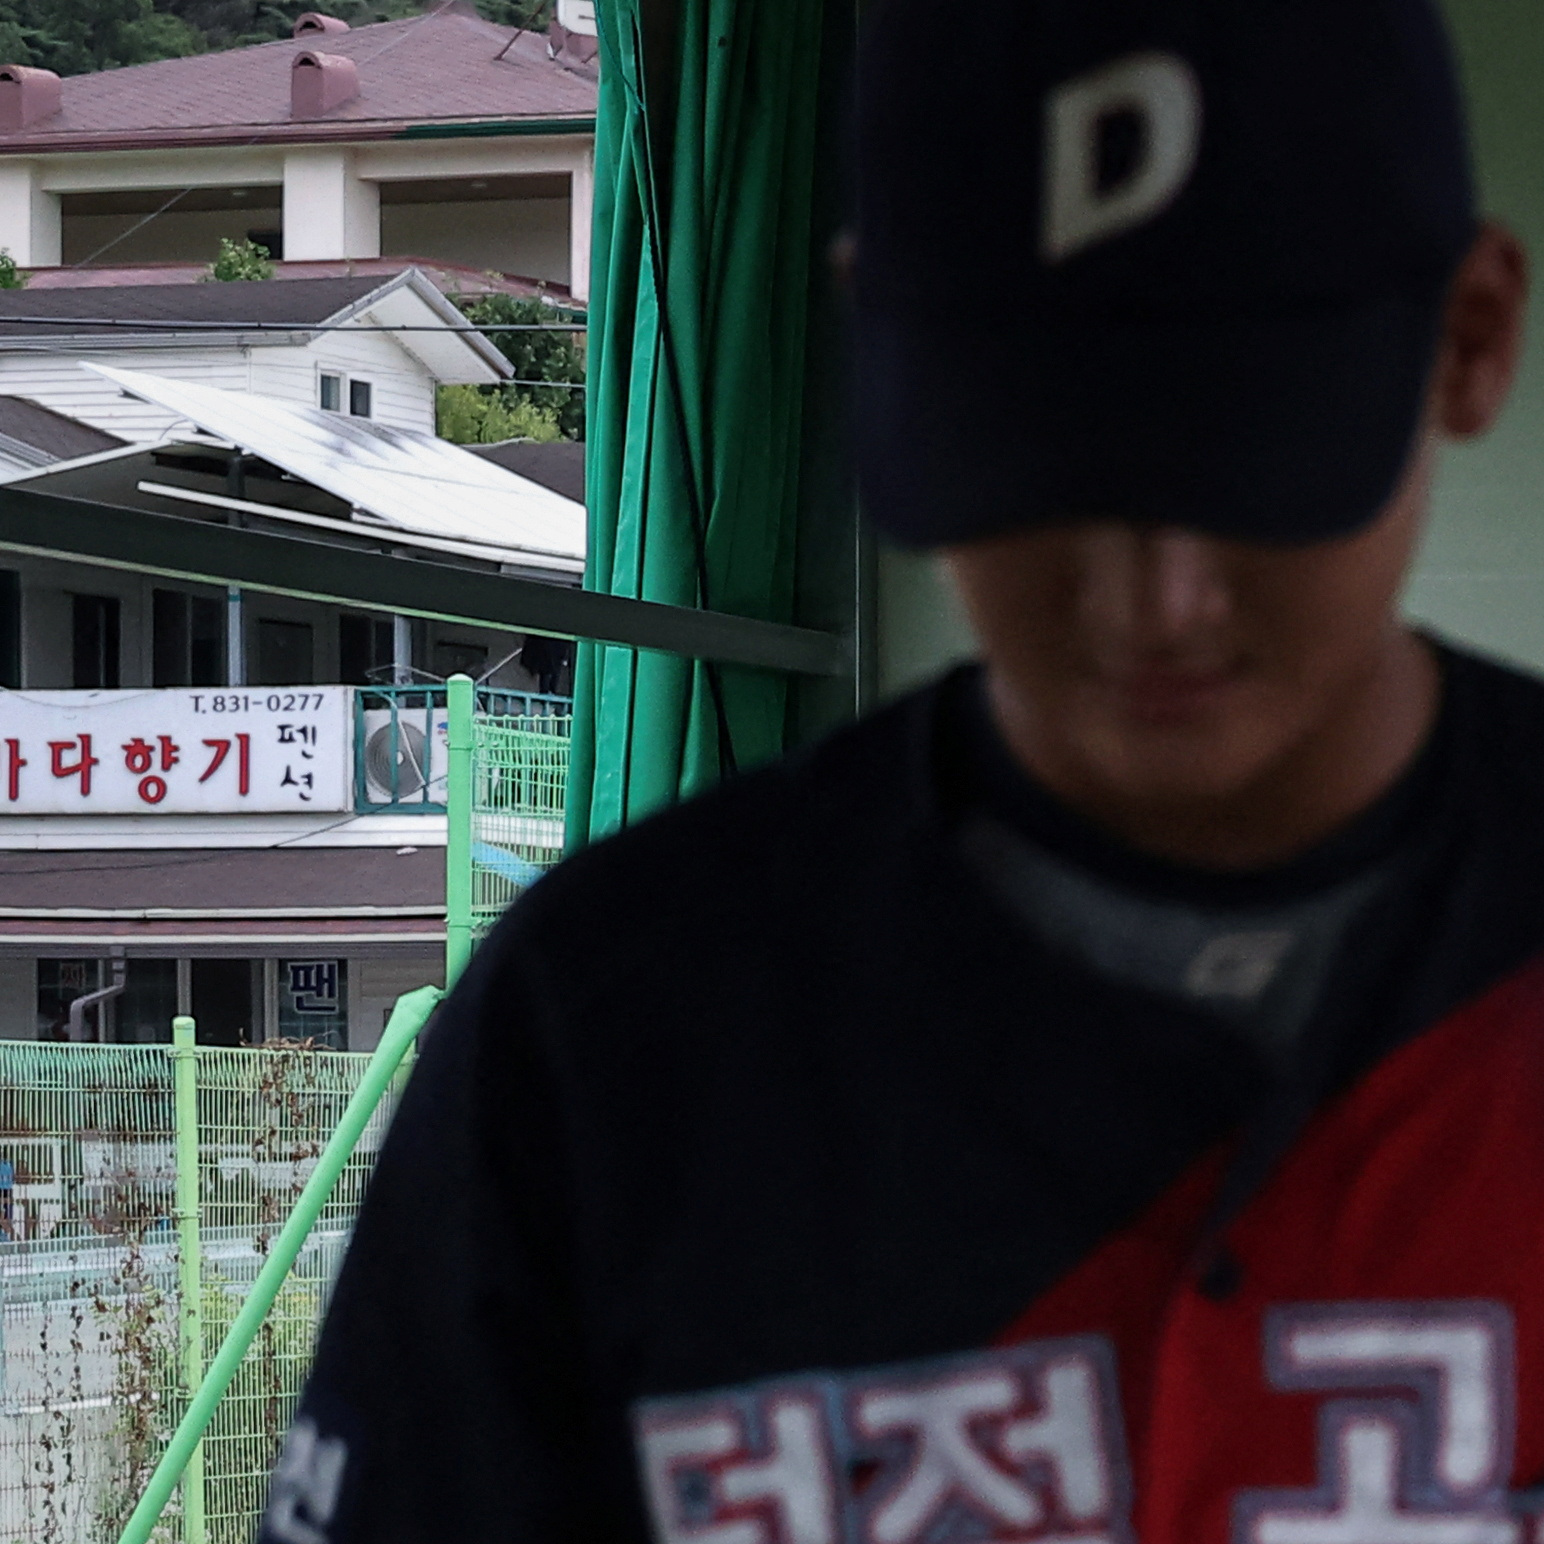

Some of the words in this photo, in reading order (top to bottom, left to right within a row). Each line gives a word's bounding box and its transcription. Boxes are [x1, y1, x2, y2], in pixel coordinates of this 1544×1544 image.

[1044, 52, 1201, 260] D
[276, 723, 318, 801] 펜션
[288, 961, 339, 1014] 팬
